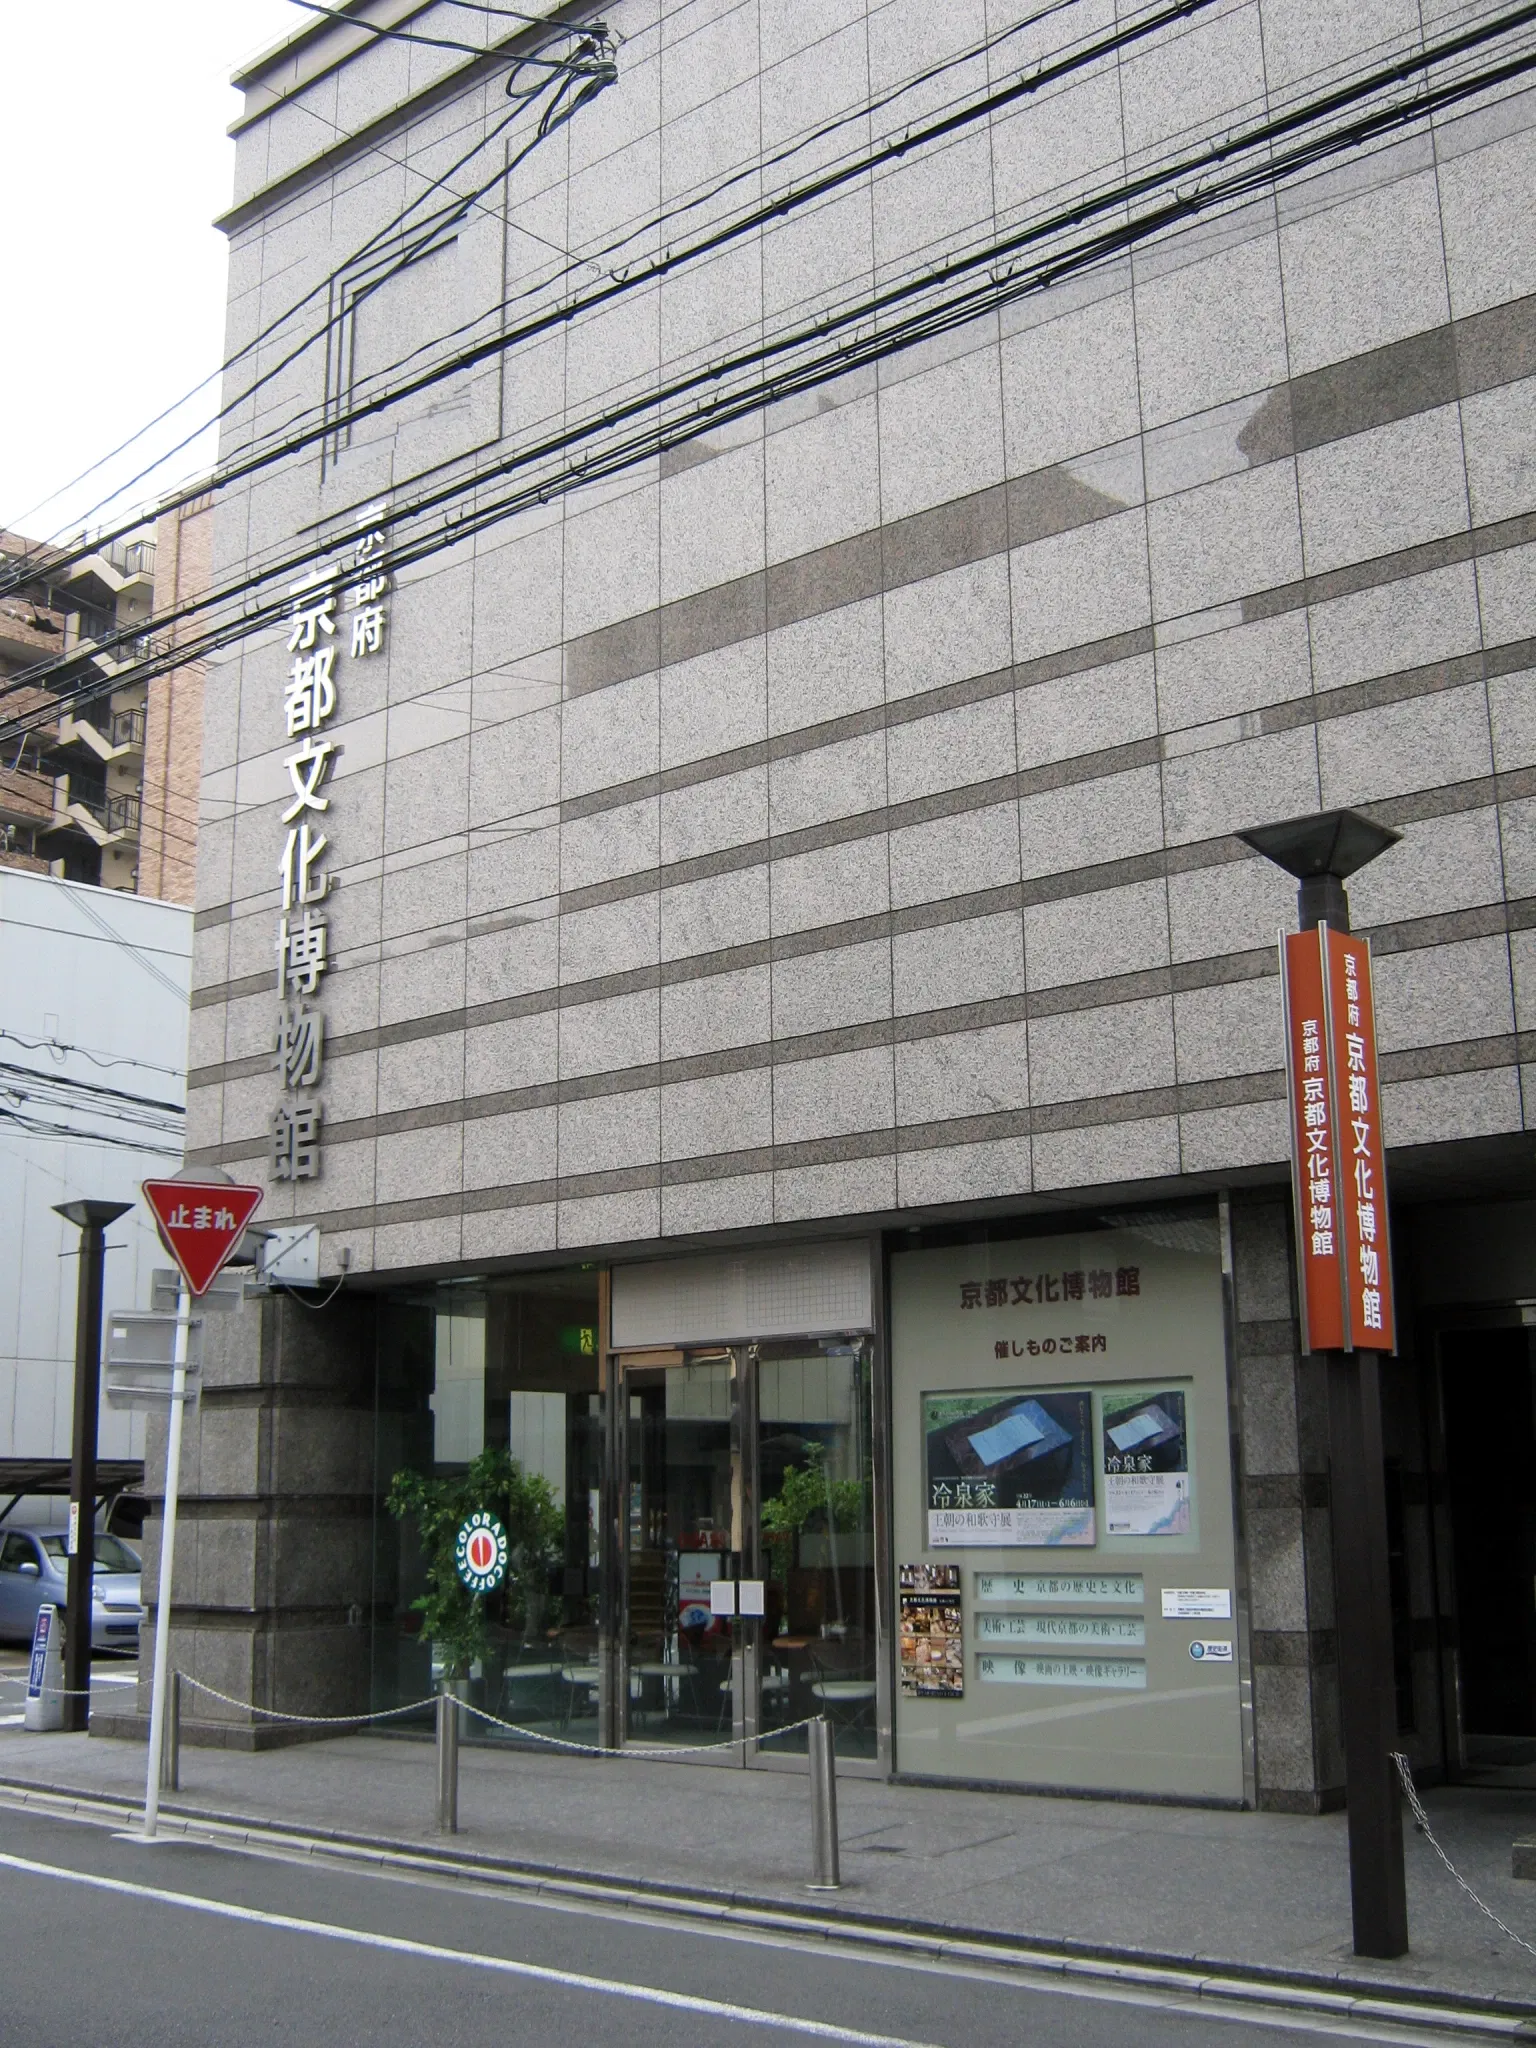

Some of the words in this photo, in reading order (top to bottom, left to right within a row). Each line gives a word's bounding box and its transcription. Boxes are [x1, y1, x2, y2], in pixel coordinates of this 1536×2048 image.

[349, 502, 389, 658] 京都府
[267, 565, 341, 1183] 京都文化博物館
[1343, 952, 1361, 1027] 京都府
[1301, 1018, 1320, 1073] 京都府
[1302, 1076, 1334, 1257] 京都文化博物館
[1345, 1031, 1382, 1331] 京都文化博物館
[167, 1203, 238, 1230] 止まれ
[959, 1266, 1141, 1310] 京都文化博物館
[994, 1333, 1107, 1360] 催しものご案内
[1107, 1454, 1153, 1473] 冷泉家
[932, 1481, 997, 1509] 冷泉家
[456, 1512, 507, 1565] COLORADO
[934, 1512, 1012, 1528] 王朝の和歌守展
[458, 1559, 503, 1590] COFFEE
